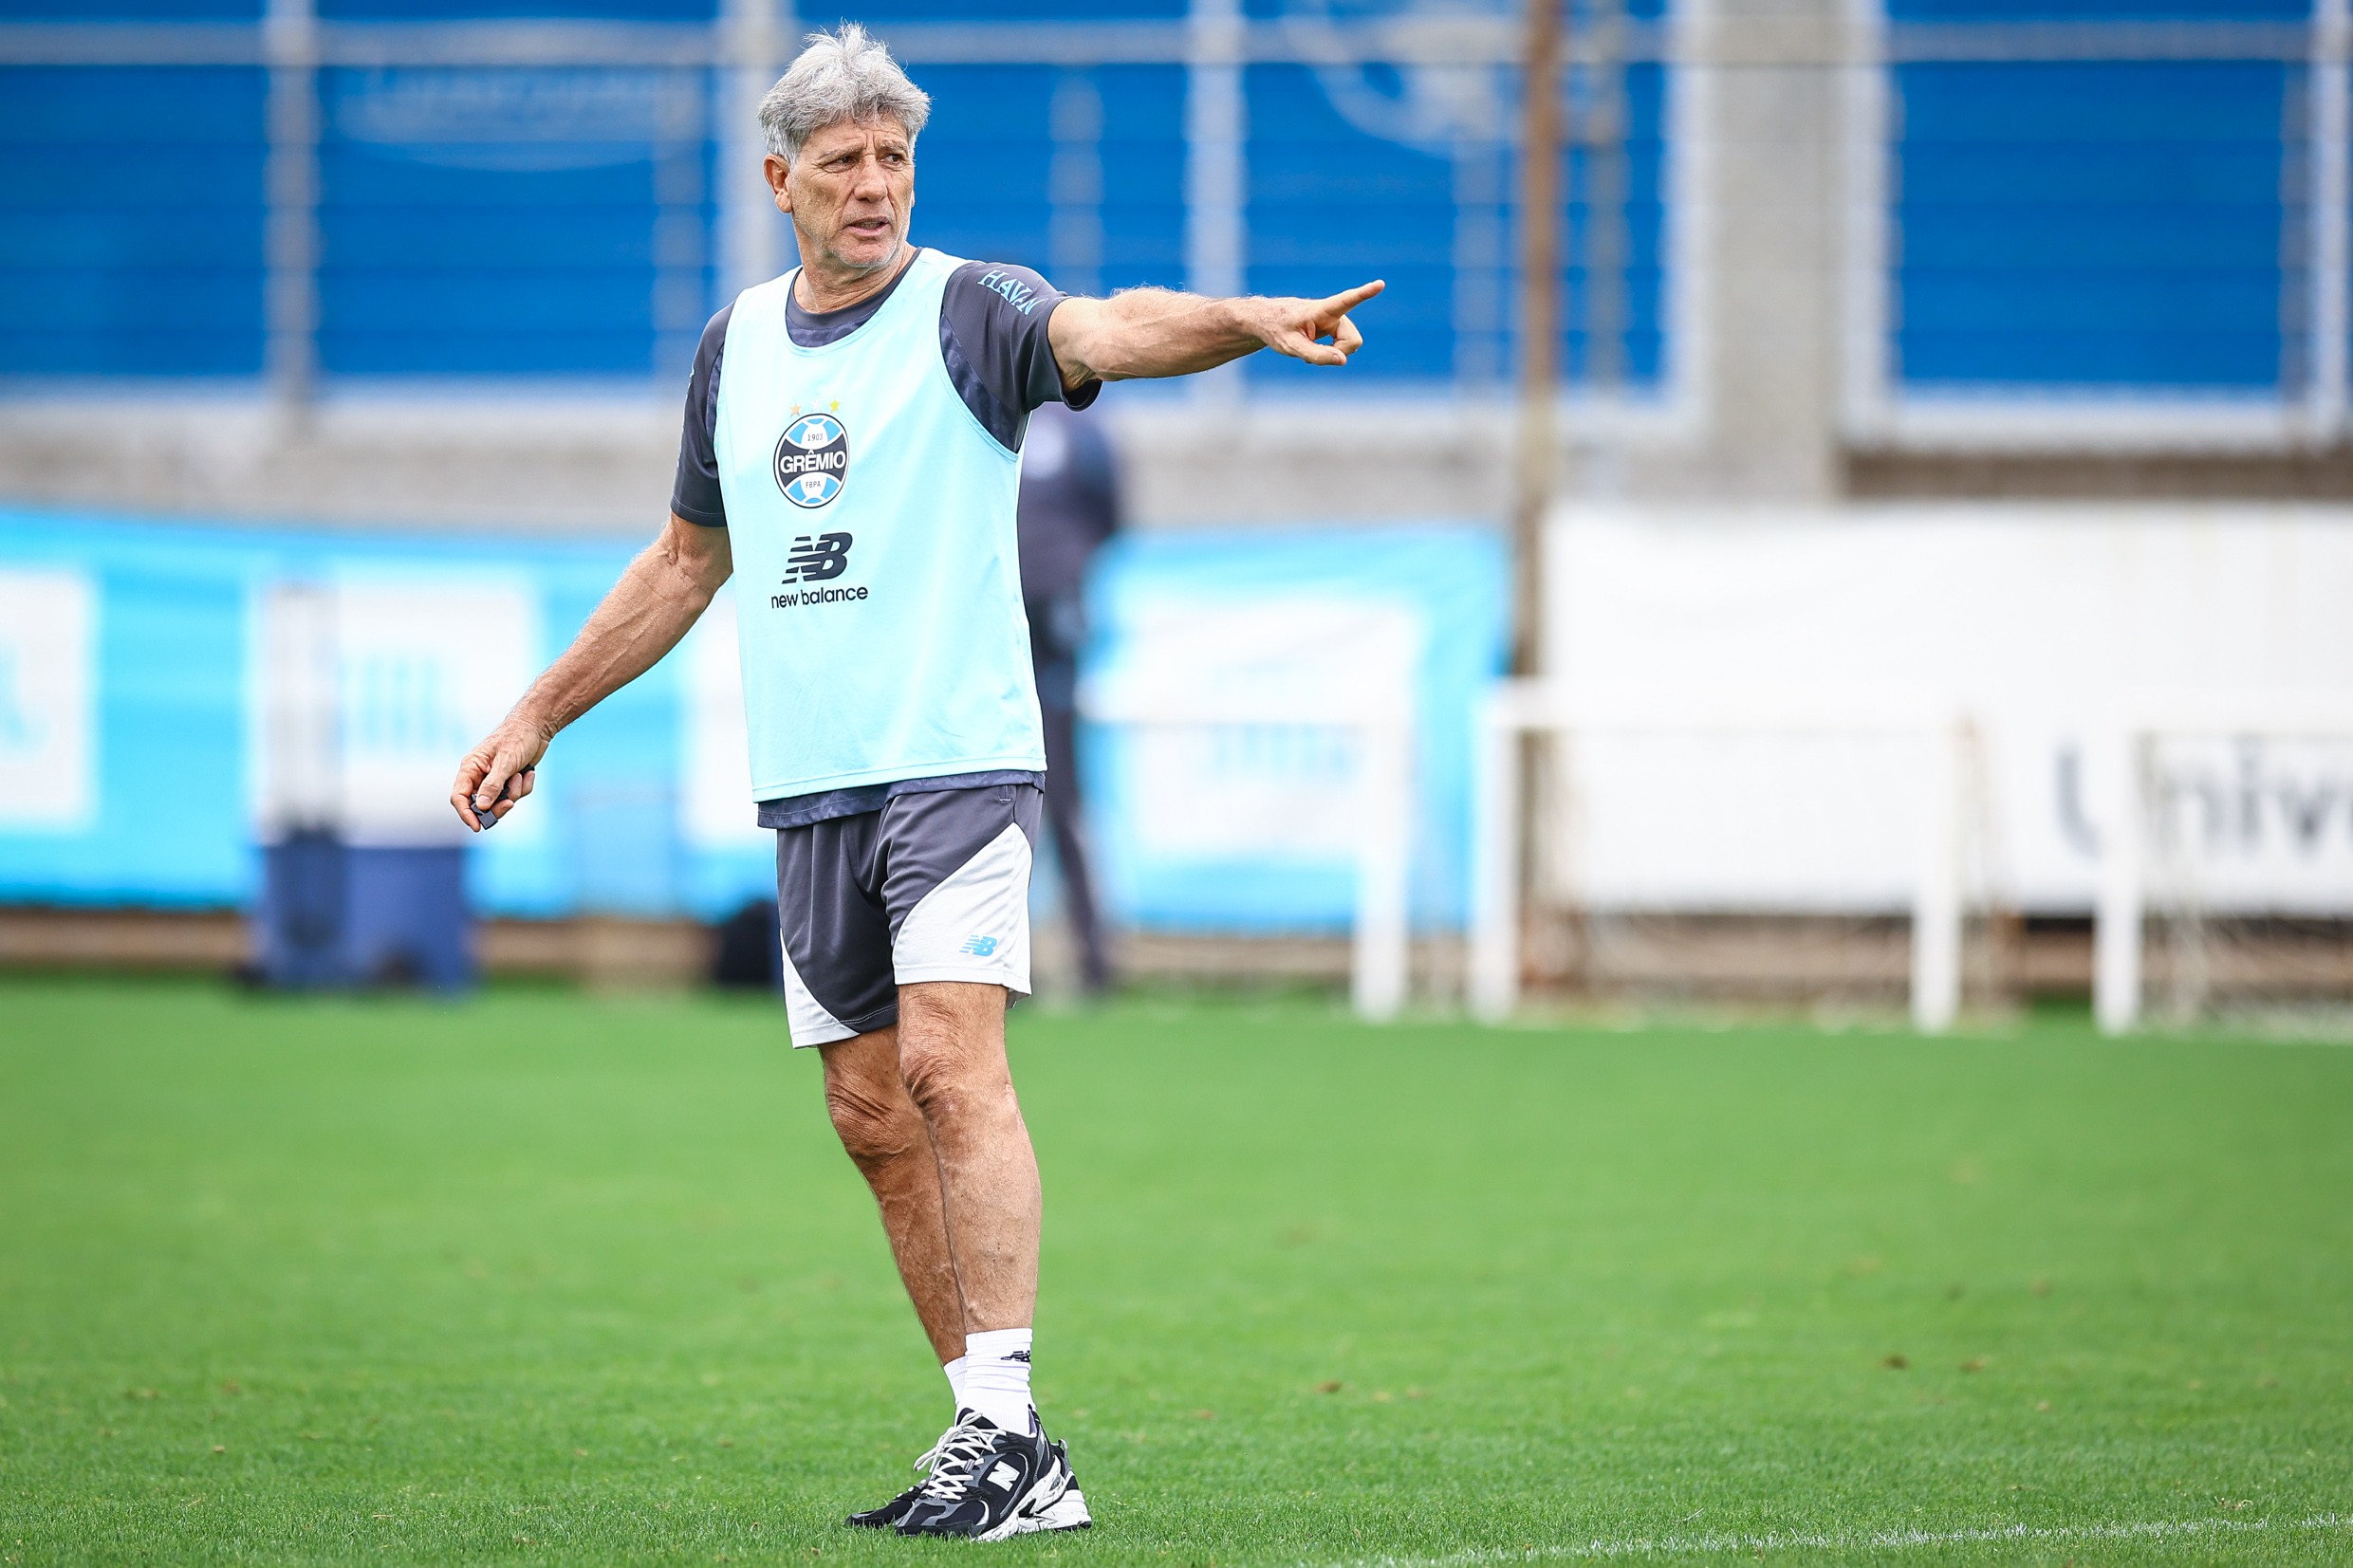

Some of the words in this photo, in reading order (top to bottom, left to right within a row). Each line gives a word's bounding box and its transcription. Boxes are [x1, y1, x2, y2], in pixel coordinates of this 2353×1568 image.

[807, 433, 824, 442] 1903
[780, 449, 847, 474] GRÊMIO
[806, 480, 822, 489] FBPA
[782, 532, 853, 584] NB
[771, 593, 799, 609] new
[801, 586, 869, 606] balance
[2053, 730, 2353, 861] Univ
[959, 934, 998, 957] NB
[987, 1460, 1021, 1493] N
